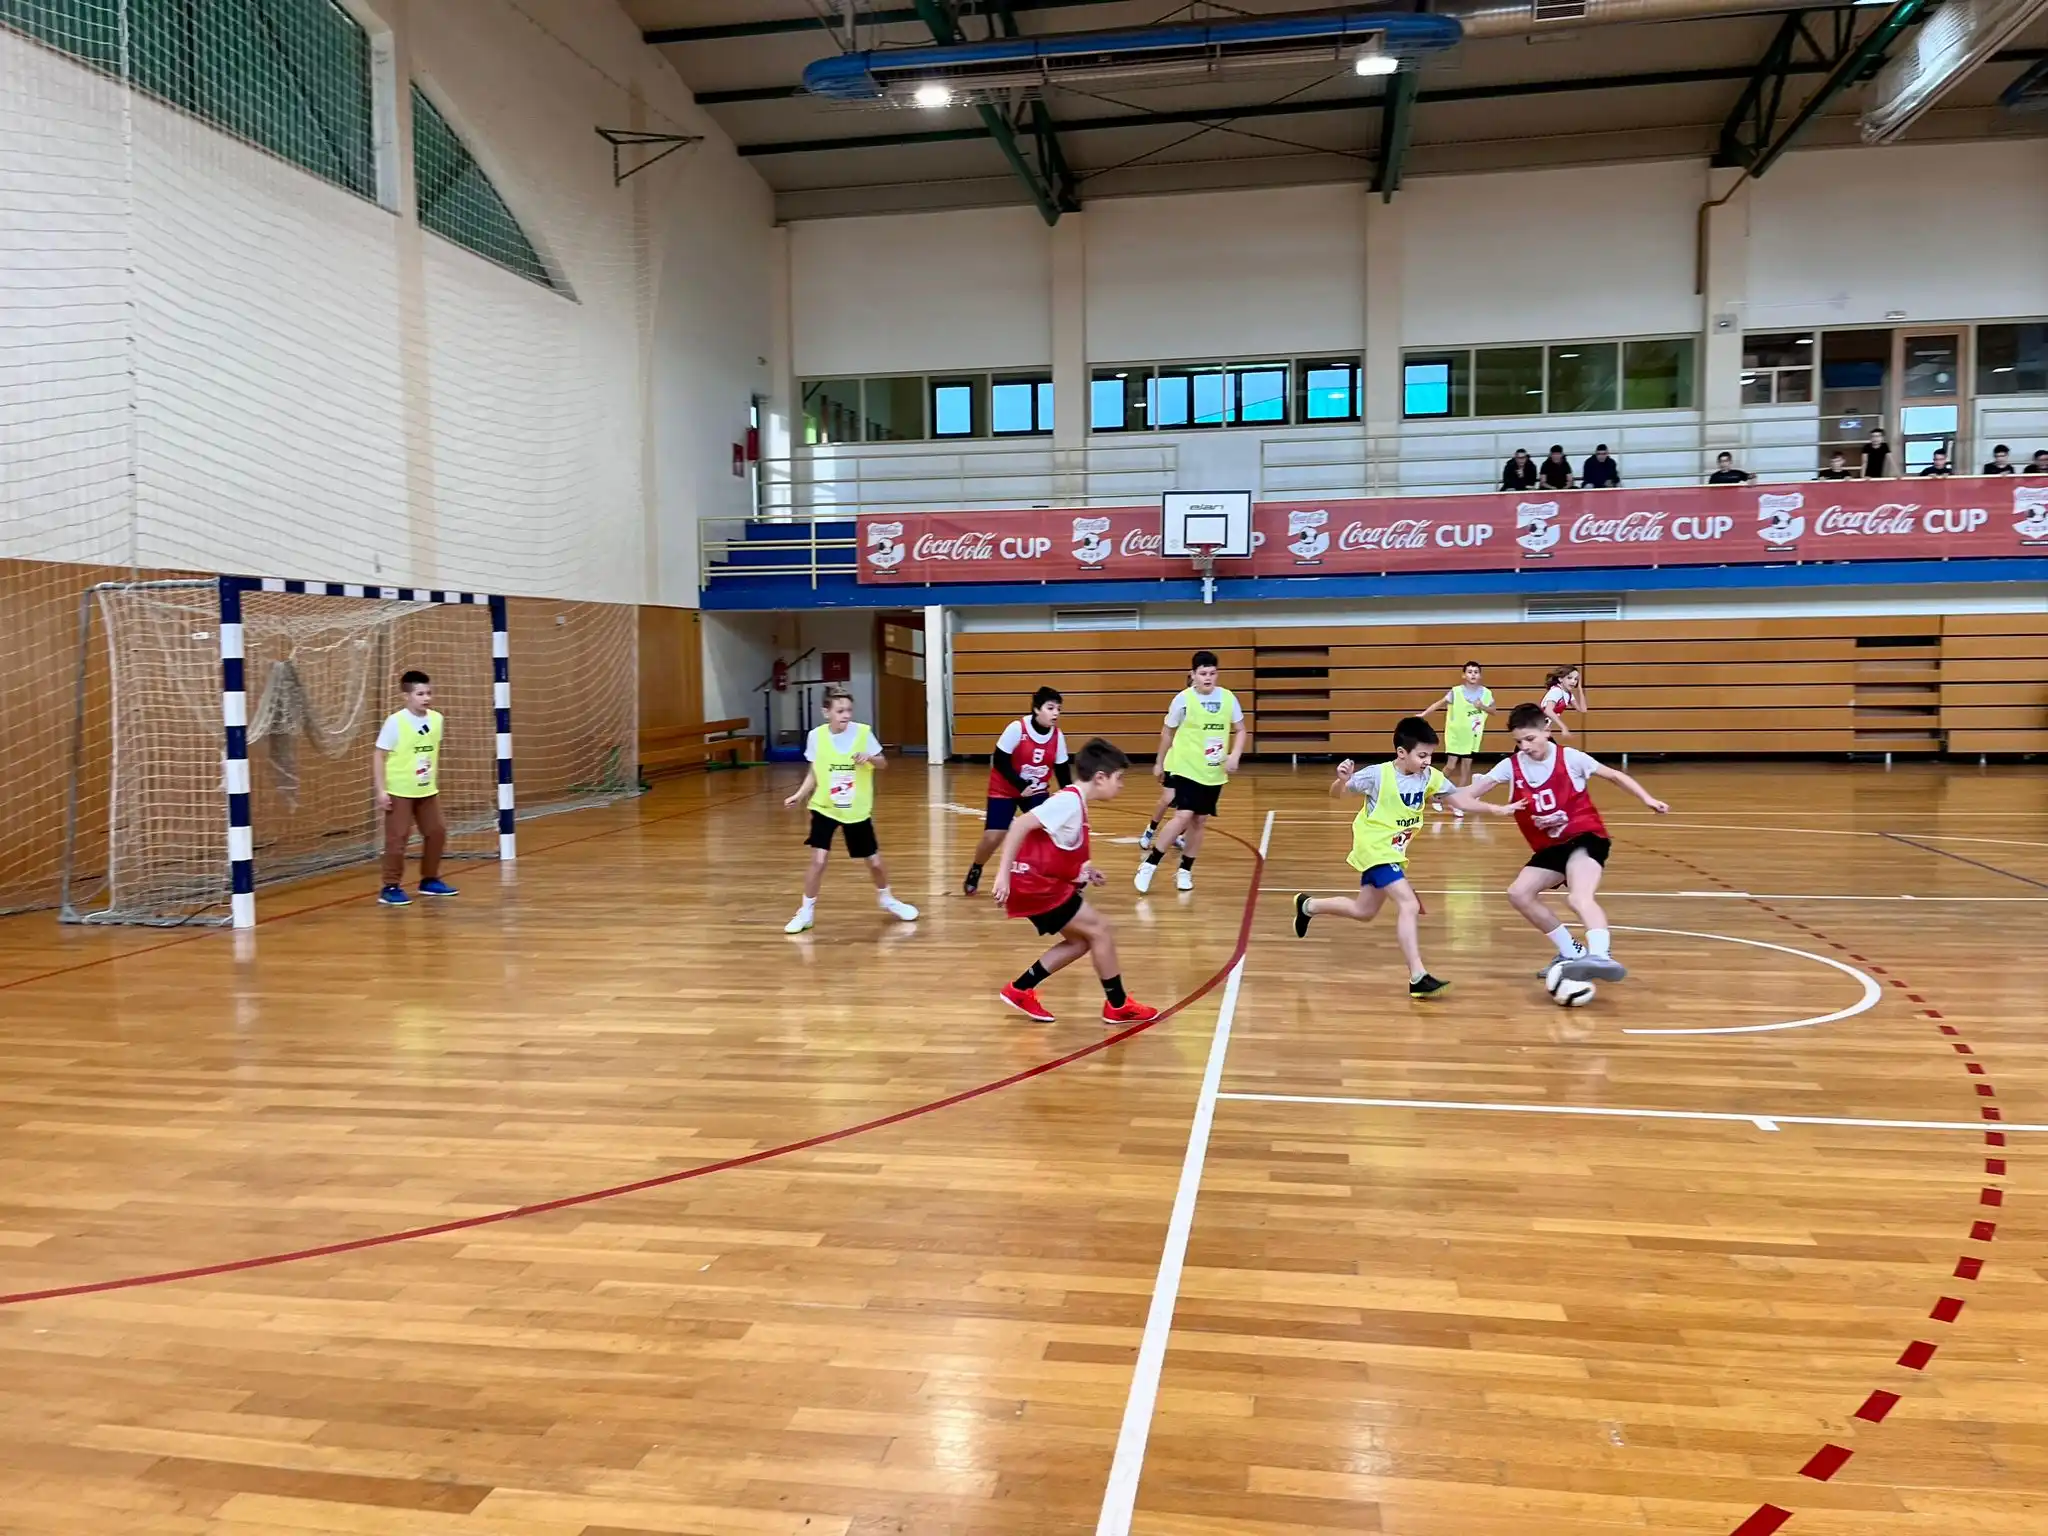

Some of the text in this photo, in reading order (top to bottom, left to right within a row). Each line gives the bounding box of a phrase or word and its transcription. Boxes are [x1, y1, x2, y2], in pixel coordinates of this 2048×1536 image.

[1338, 519, 1494, 551] Coca-Cola CUP
[1569, 511, 1734, 544] Coca-Cola CUP
[1814, 503, 1989, 536] Coca-Cola CUP
[912, 532, 1052, 561] Coca-Cola CUP
[1532, 788, 1557, 813] 10
